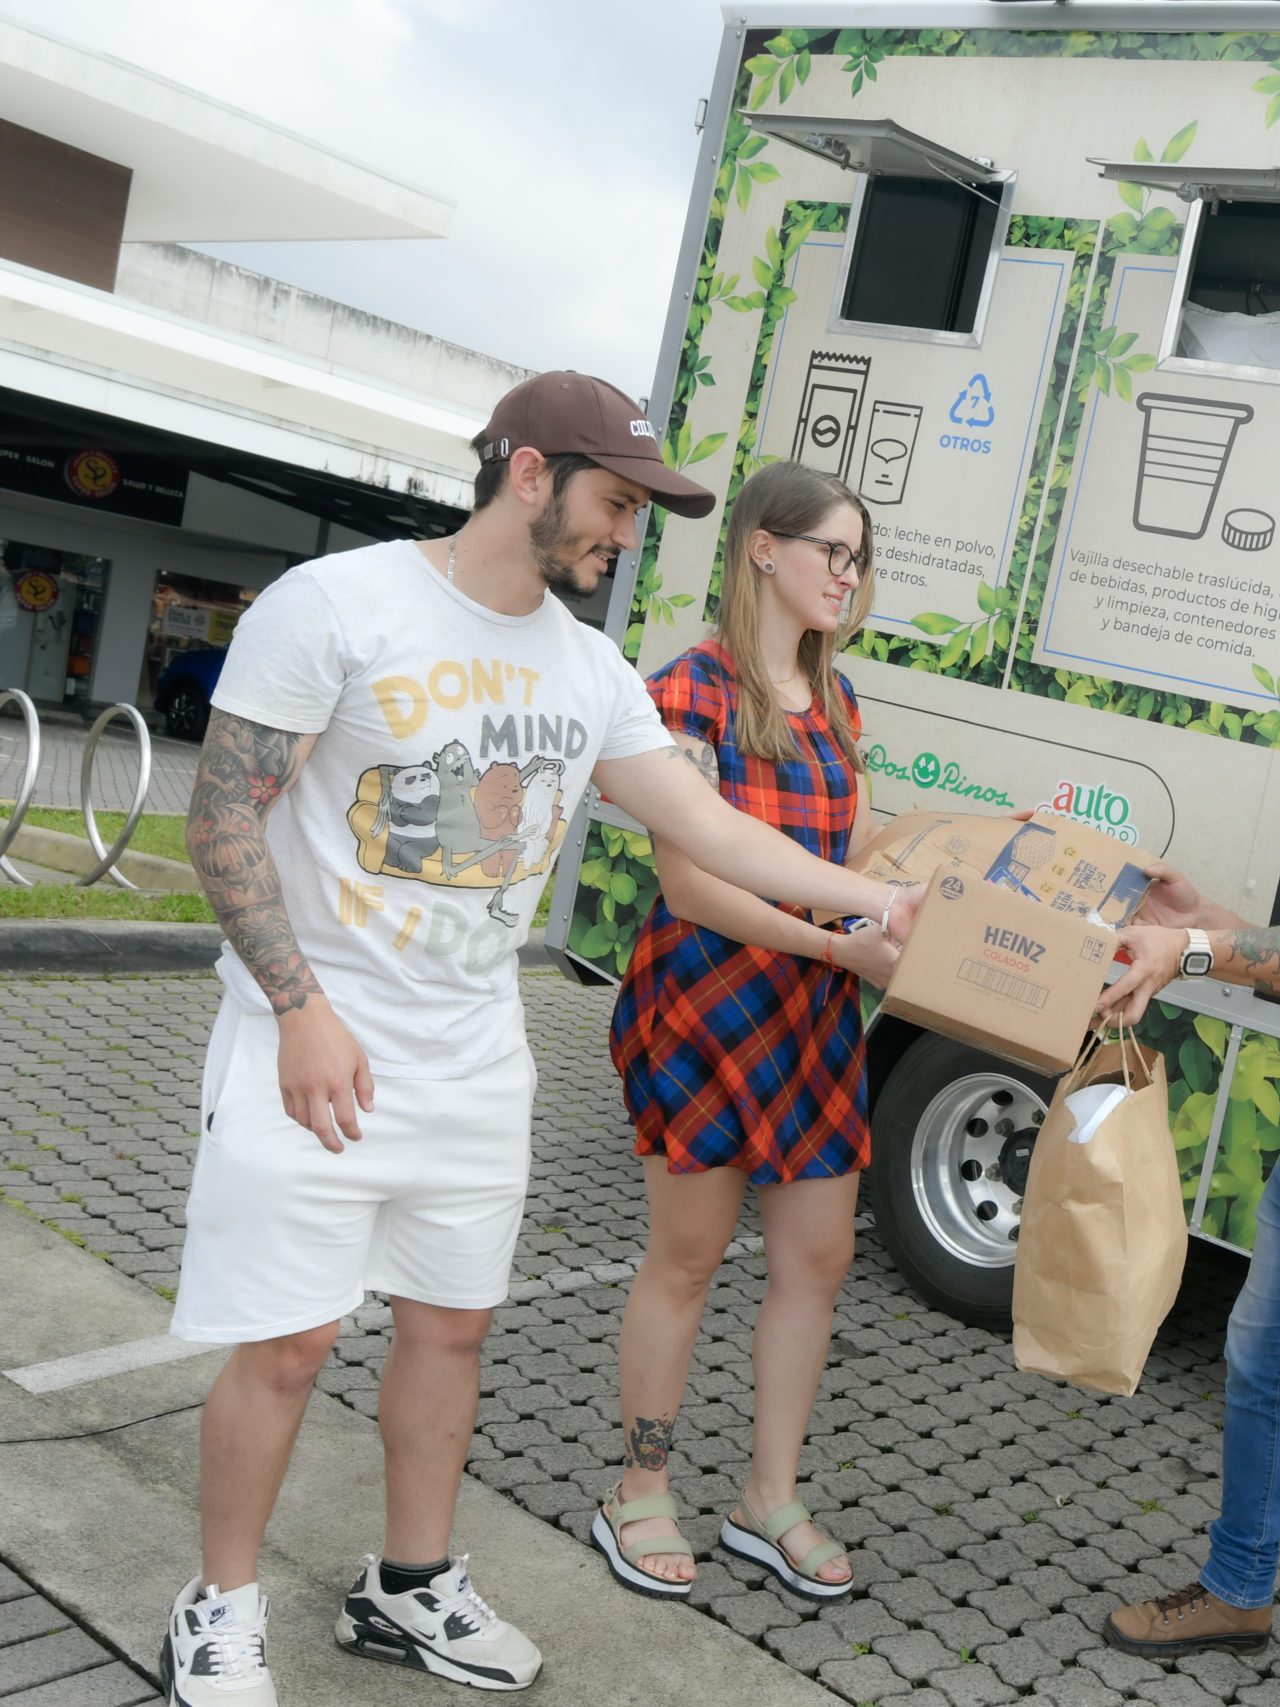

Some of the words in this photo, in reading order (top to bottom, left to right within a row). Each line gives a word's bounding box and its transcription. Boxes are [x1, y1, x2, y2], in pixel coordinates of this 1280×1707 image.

[970, 395, 981, 409] 7
[25, 455, 55, 468] SALON
[939, 434, 992, 454] OTROS
[872, 522, 891, 538] do:
[894, 525, 931, 545] leche
[934, 536, 952, 549] en
[955, 539, 996, 559] polvo,
[885, 546, 985, 578] deshidratadas,
[891, 570, 928, 588] otros.
[1070, 548, 1109, 568] Vajilla
[1112, 556, 1194, 583] desechable
[1198, 572, 1274, 599] traslúcida,
[1069, 569, 1087, 583] de
[1091, 571, 1148, 597] bebidas,
[1152, 585, 1227, 610] productos
[1230, 599, 1249, 614] de
[1094, 595, 1104, 610] y
[1107, 595, 1169, 622] limpieza,
[1173, 608, 1277, 640] contenedores
[1100, 616, 1111, 631] y
[1114, 617, 1171, 642] bandeja
[1175, 629, 1193, 644] de
[1197, 636, 1256, 658] comida.
[371, 658, 541, 740] DON'T
[479, 713, 588, 760] MIND
[866, 744, 911, 781] Dos
[937, 761, 1015, 809] Pinos
[1053, 782, 1129, 826] auto
[338, 876, 385, 928] IF
[945, 877, 962, 891] 24
[983, 925, 1046, 964] HEINZ
[983, 948, 1031, 973] COLADOS
[211, 1606, 227, 1617] NIKE
